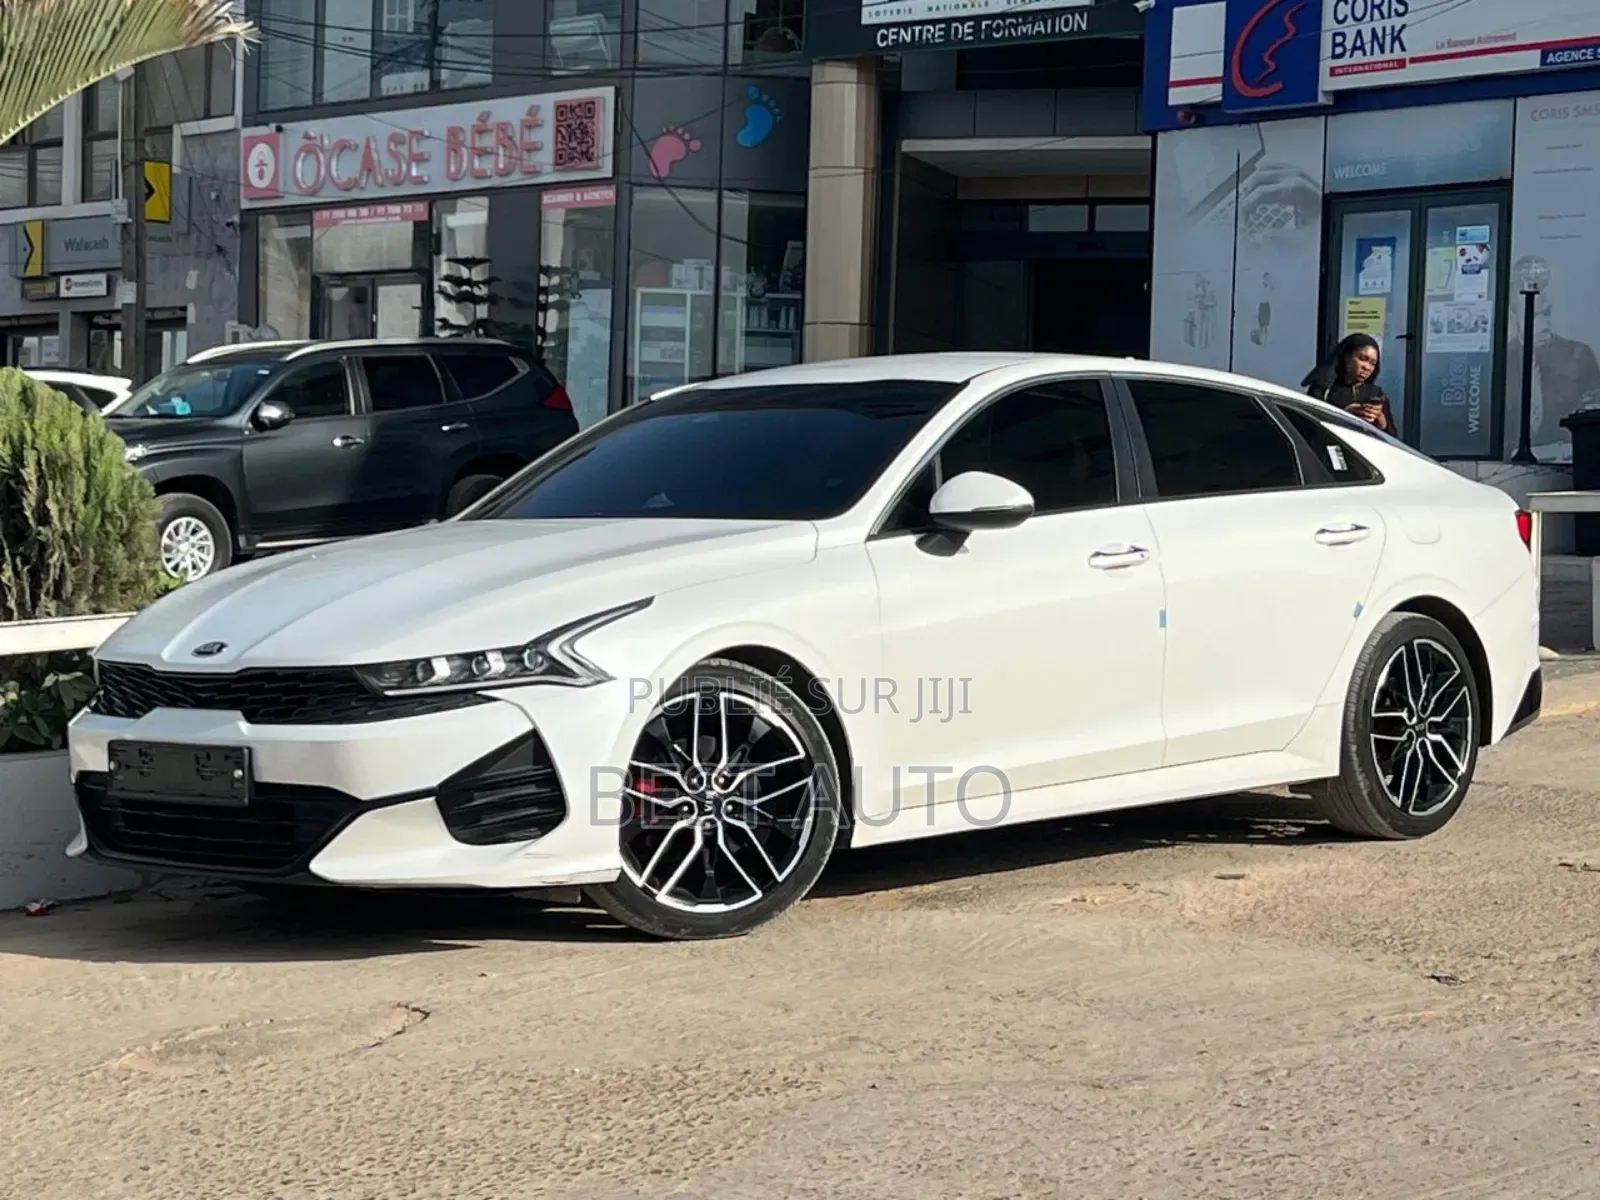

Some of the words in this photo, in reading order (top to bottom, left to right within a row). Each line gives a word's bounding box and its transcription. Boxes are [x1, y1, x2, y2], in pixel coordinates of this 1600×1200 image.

[927, 1, 990, 12] NATIONALE
[1332, 0, 1410, 25] CORIS
[876, 24, 946, 48] CENTRE
[950, 21, 975, 40] DE
[980, 12, 1088, 39] FORMATION
[1330, 24, 1408, 60] BANK
[1546, 48, 1595, 65] AGENCE
[1333, 61, 1399, 76] INTERNATIONAL
[1530, 106, 1570, 121] CORIS
[445, 104, 545, 181] BÉBÉ
[1333, 161, 1389, 181] WELCOME
[1467, 365, 1481, 435] WELCOME
